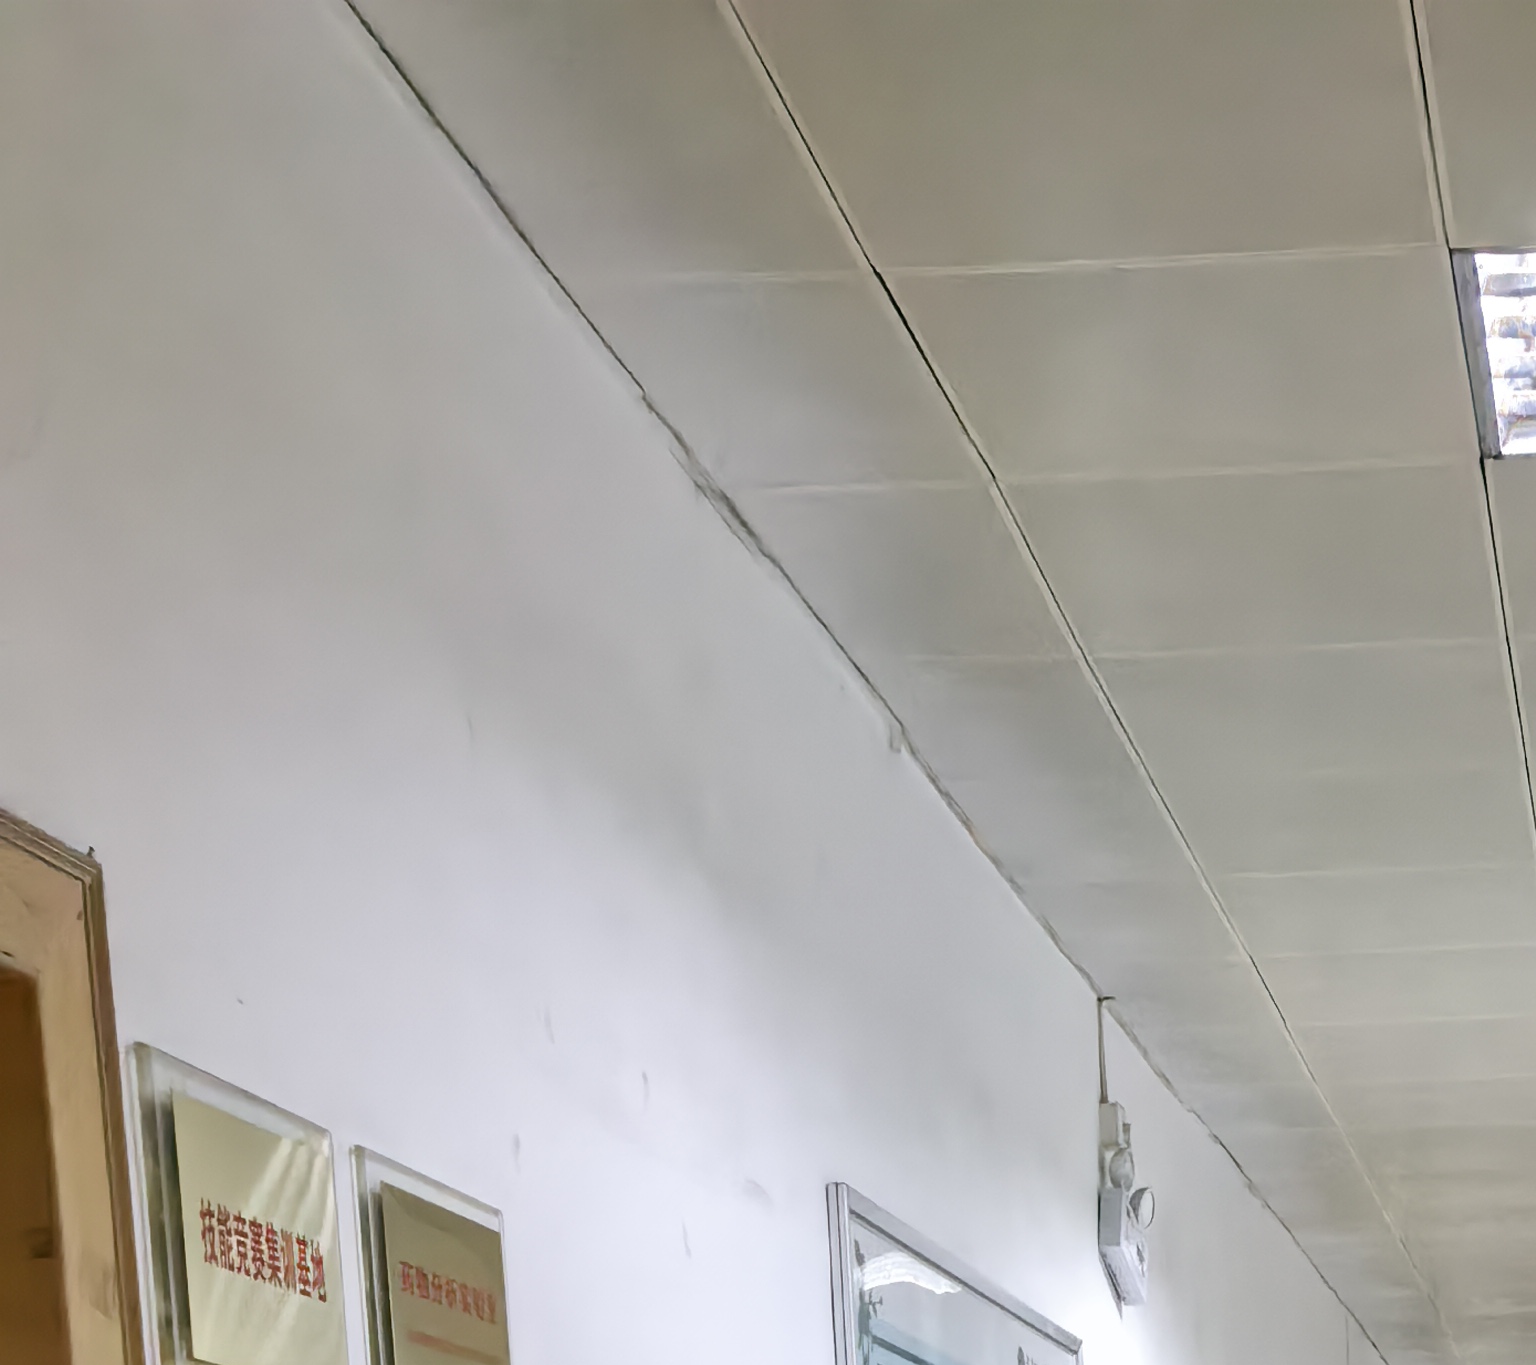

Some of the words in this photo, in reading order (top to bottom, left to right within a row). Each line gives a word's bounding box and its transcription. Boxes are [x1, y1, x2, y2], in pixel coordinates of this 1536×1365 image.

[200, 1197, 328, 1303] 技能竞赛集训基地
